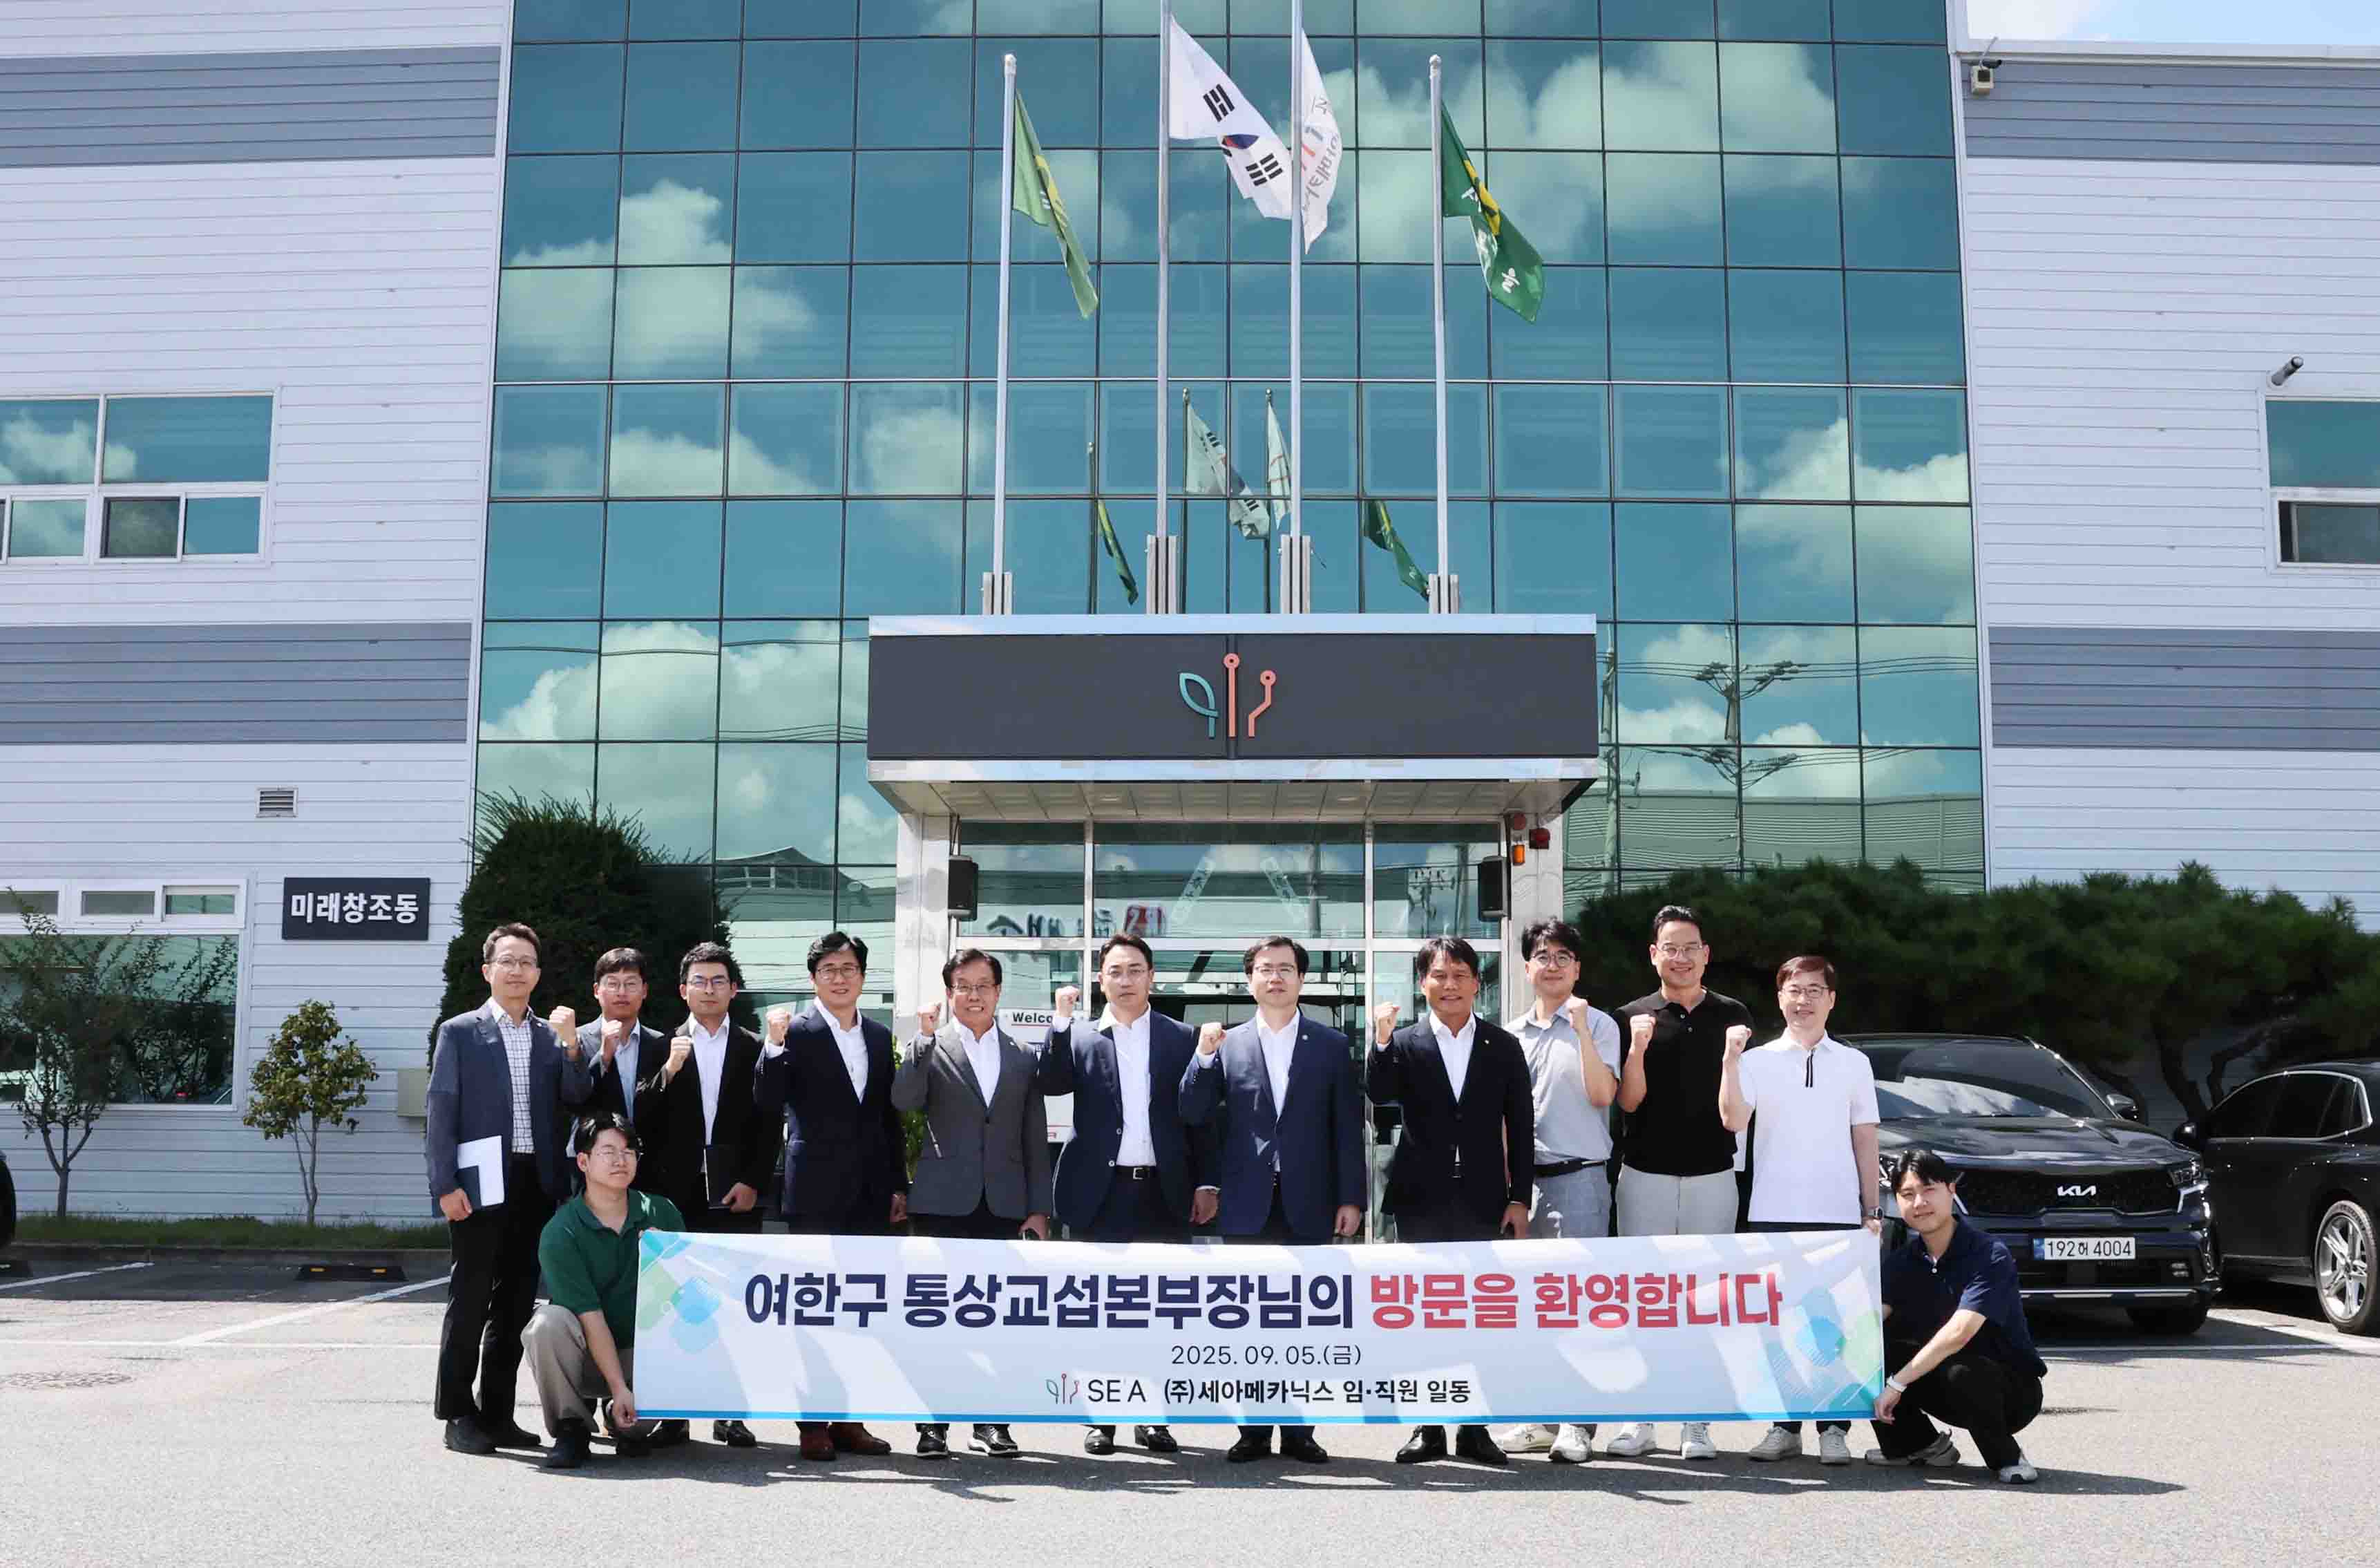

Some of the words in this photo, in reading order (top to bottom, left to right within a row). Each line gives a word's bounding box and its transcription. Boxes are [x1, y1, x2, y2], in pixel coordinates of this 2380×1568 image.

[291, 892, 419, 924] 미래창조동
[1013, 1012, 1075, 1023] Welco
[2057, 1185, 2097, 1196] KIA
[2093, 1240, 2131, 1257] 4004
[745, 1272, 888, 1328] 여한구
[903, 1274, 1353, 1330] 통상교섭본부장님의
[1371, 1274, 1519, 1328] 방문을
[1533, 1272, 1783, 1329] 환영합니다
[1088, 1379, 1146, 1403] SEA
[1164, 1378, 1335, 1405] (주)세아메카닉스
[1342, 1379, 1418, 1404] 임·직원
[1427, 1380, 1471, 1404] 일동
